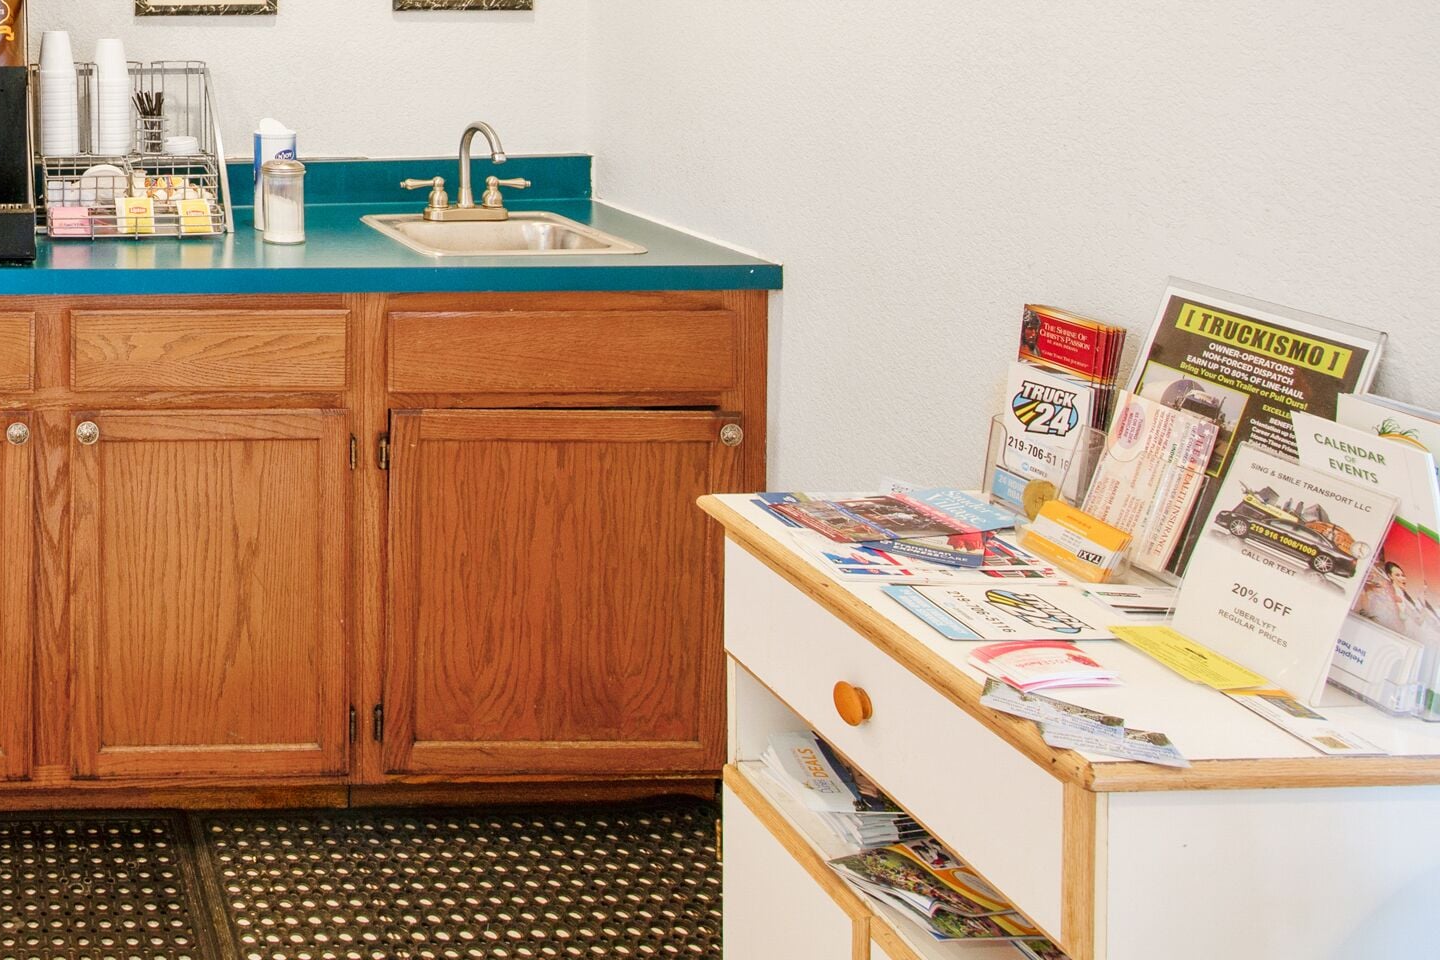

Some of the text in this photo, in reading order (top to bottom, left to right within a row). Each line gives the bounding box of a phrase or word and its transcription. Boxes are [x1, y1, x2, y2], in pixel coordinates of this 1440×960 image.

[1043, 322, 1056, 333] THE
[1198, 312, 1325, 367] TRUCKISMO
[1065, 336, 1091, 351] PASSION
[1202, 350, 1295, 386] NON-FORCED DISPATCH
[1209, 342, 1295, 376] OWNER-OPERATORS
[1179, 361, 1309, 412] Bring Your Own Trailer or Pull Ours!
[1186, 354, 1305, 401] EARN UP TO 80% OF LINE-HAUL
[1022, 380, 1077, 409] TRUCK
[1025, 401, 1073, 437] 24
[1249, 418, 1281, 434] Orientation
[1262, 404, 1292, 420] EXCELLE
[1269, 417, 1294, 431] BENEFI
[1250, 433, 1281, 449] Home-Time
[1251, 426, 1269, 436] Career
[1167, 443, 1178, 464] UNDER
[1313, 433, 1386, 466] CALENDAR
[1344, 454, 1357, 464] OF
[1328, 457, 1379, 485] EVENTS
[1250, 462, 1270, 475] SING
[1277, 472, 1301, 487] SMILE
[1303, 481, 1353, 506] TRANSPORT
[1354, 499, 1372, 514] LLC
[1153, 504, 1182, 554] INSURANCE
[1249, 522, 1318, 557] 219 916 1008/1009
[1078, 549, 1102, 565] TAXI
[1241, 548, 1297, 578] CALL OR TEXT
[1231, 582, 1293, 618] 20% OFF
[1218, 608, 1289, 649] REGULAR PRICES
[1233, 607, 1278, 633] UBER/LYFT
[796, 746, 830, 780] DEALS
